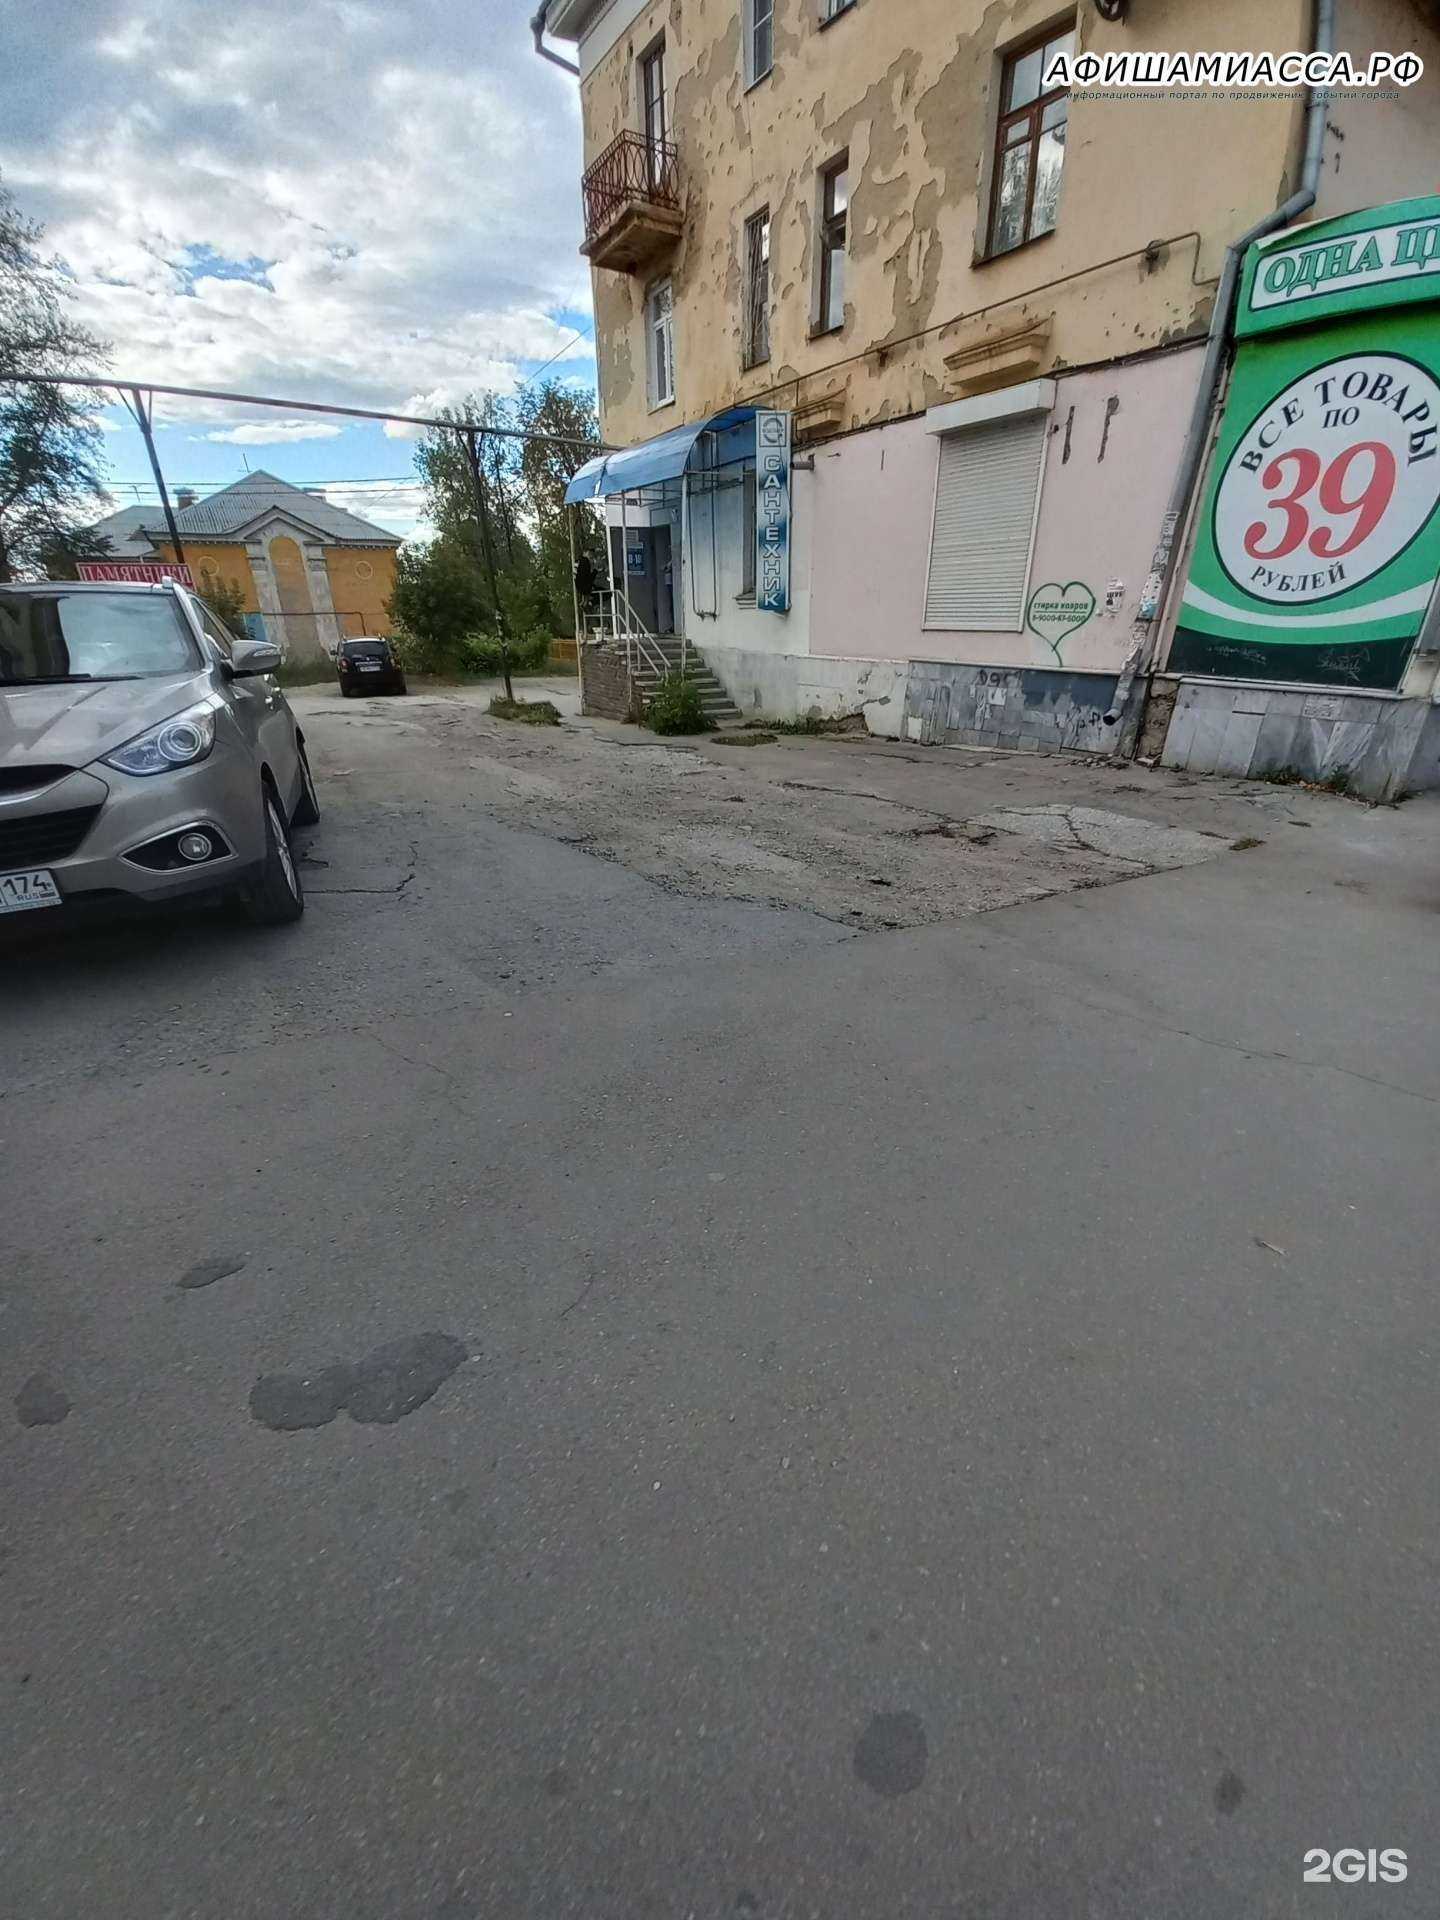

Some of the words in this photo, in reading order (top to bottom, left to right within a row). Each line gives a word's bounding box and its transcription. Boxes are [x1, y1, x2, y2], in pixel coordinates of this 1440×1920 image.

[1263, 236, 1383, 297] ОДНА
[1239, 398, 1304, 473] ВСЕ
[1314, 371, 1438, 468] ТОВАРЫ
[1322, 406, 1360, 428] ПО
[1243, 441, 1396, 560] 39
[763, 454, 781, 607] САНТЕХНИК
[80, 565, 191, 584] ПАМЯТНИКИ
[1250, 561, 1347, 592] РУБЛЕЙ
[3, 874, 48, 896] 174
[16, 892, 40, 901] RUS
